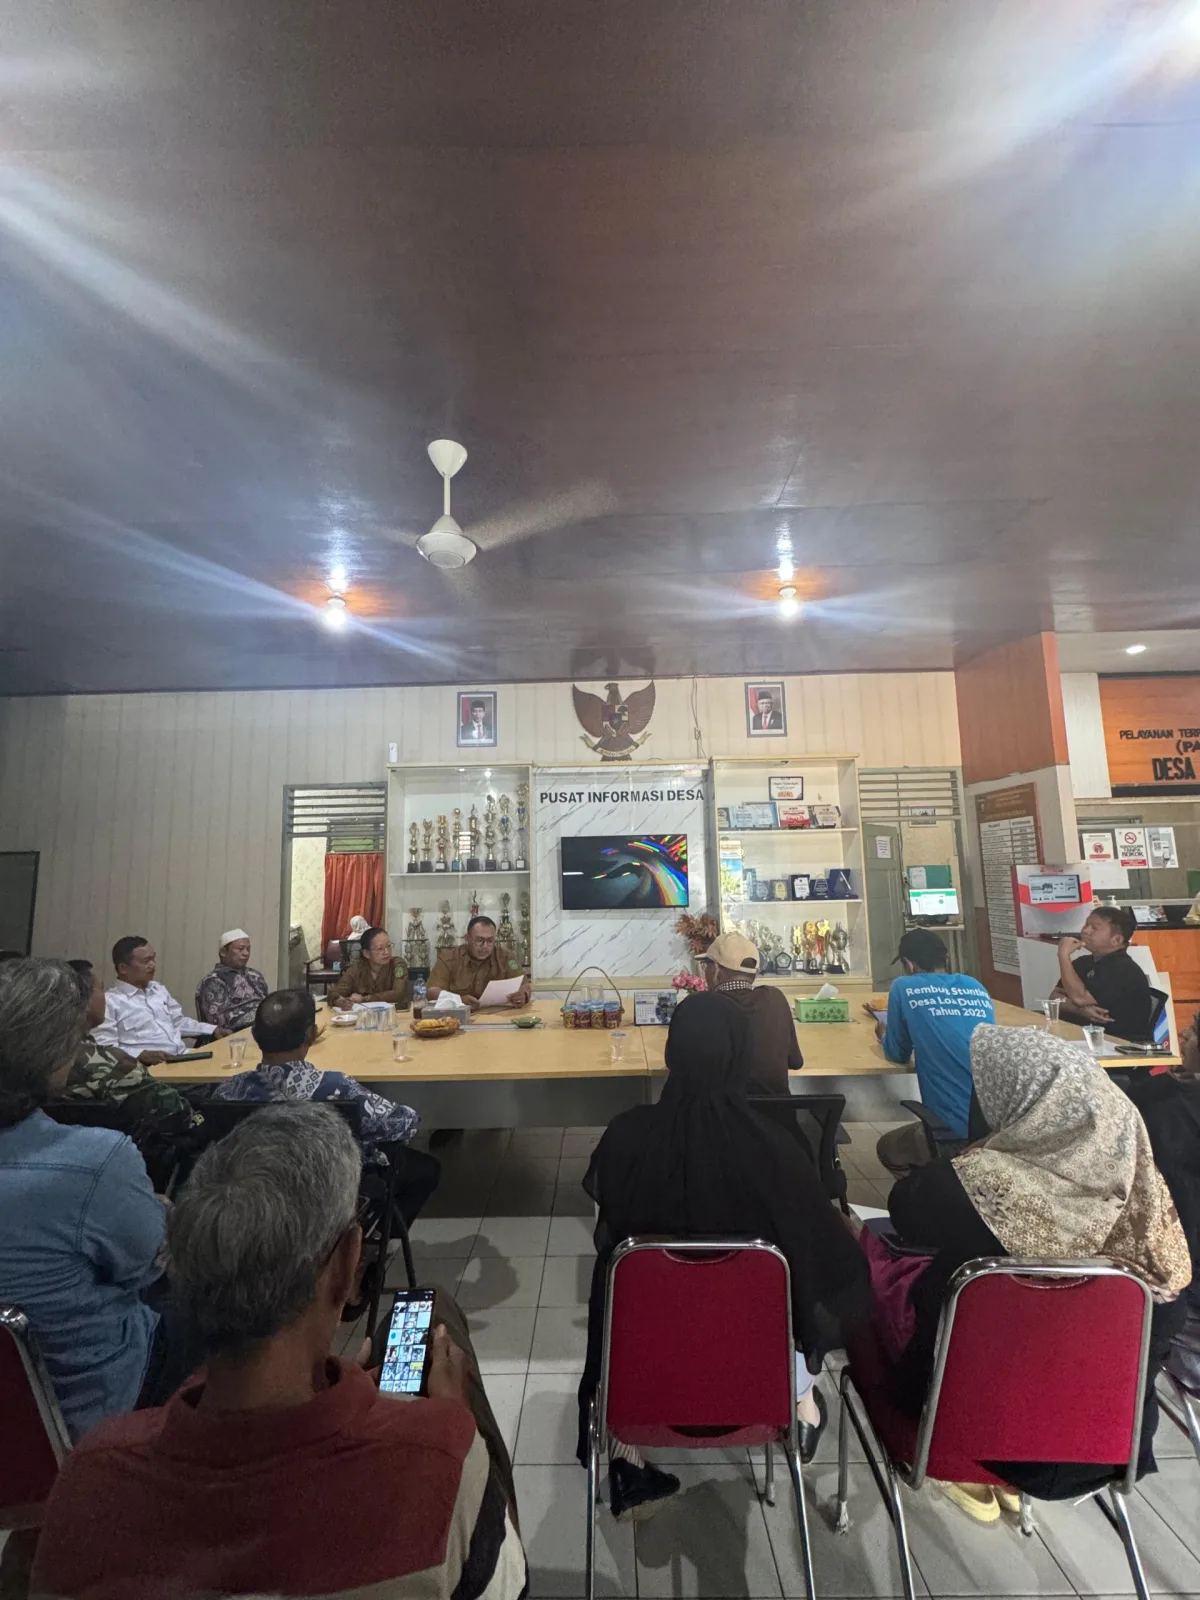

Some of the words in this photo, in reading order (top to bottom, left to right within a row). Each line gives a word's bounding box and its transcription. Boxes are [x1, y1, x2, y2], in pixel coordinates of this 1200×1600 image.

[1119, 729, 1174, 740] PELAYANAN
[1151, 757, 1197, 781] DESA
[540, 791, 584, 803] PUSAT
[588, 789, 663, 803] INFORMASI
[667, 789, 704, 801] DESA
[908, 998, 937, 1010] Desa
[957, 997, 982, 1007] Duri
[928, 1007, 961, 1017] Tahun
[962, 1007, 987, 1018] 2023
